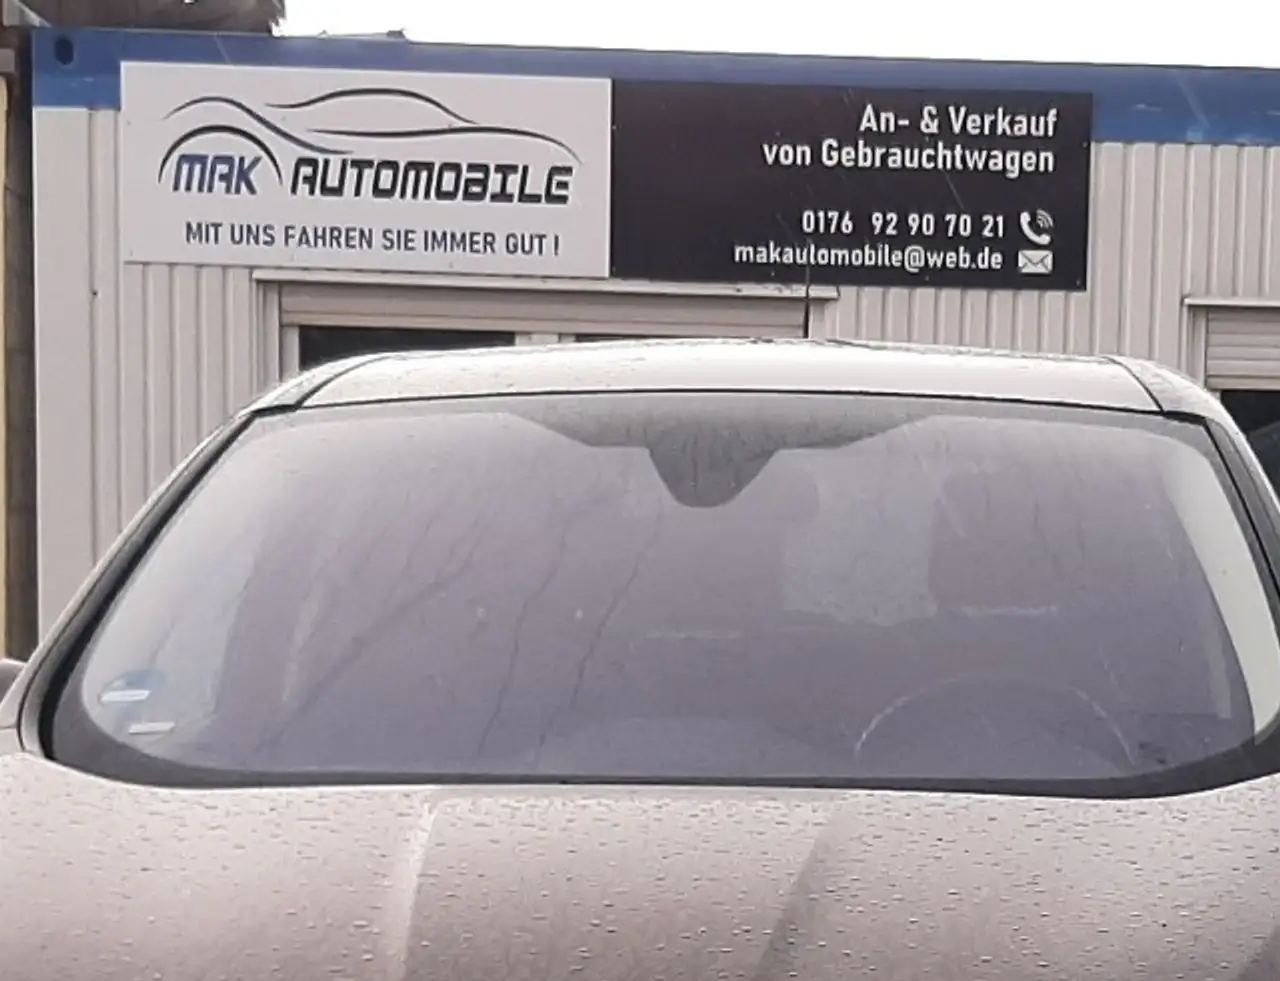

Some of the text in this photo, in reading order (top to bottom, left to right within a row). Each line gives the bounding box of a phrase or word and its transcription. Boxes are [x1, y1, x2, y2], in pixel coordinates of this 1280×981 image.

[859, 104, 1057, 137] An- & Verkauf
[762, 138, 1055, 179] von Gebrauchtwagen
[172, 153, 573, 203] MAK AUTOMOBILE
[185, 220, 561, 257] MIT UNS FAHREN SIE IMMER GUT !
[802, 210, 1005, 239] 0176 92 90 70 21
[734, 241, 1003, 273] makautomobile@web.de
